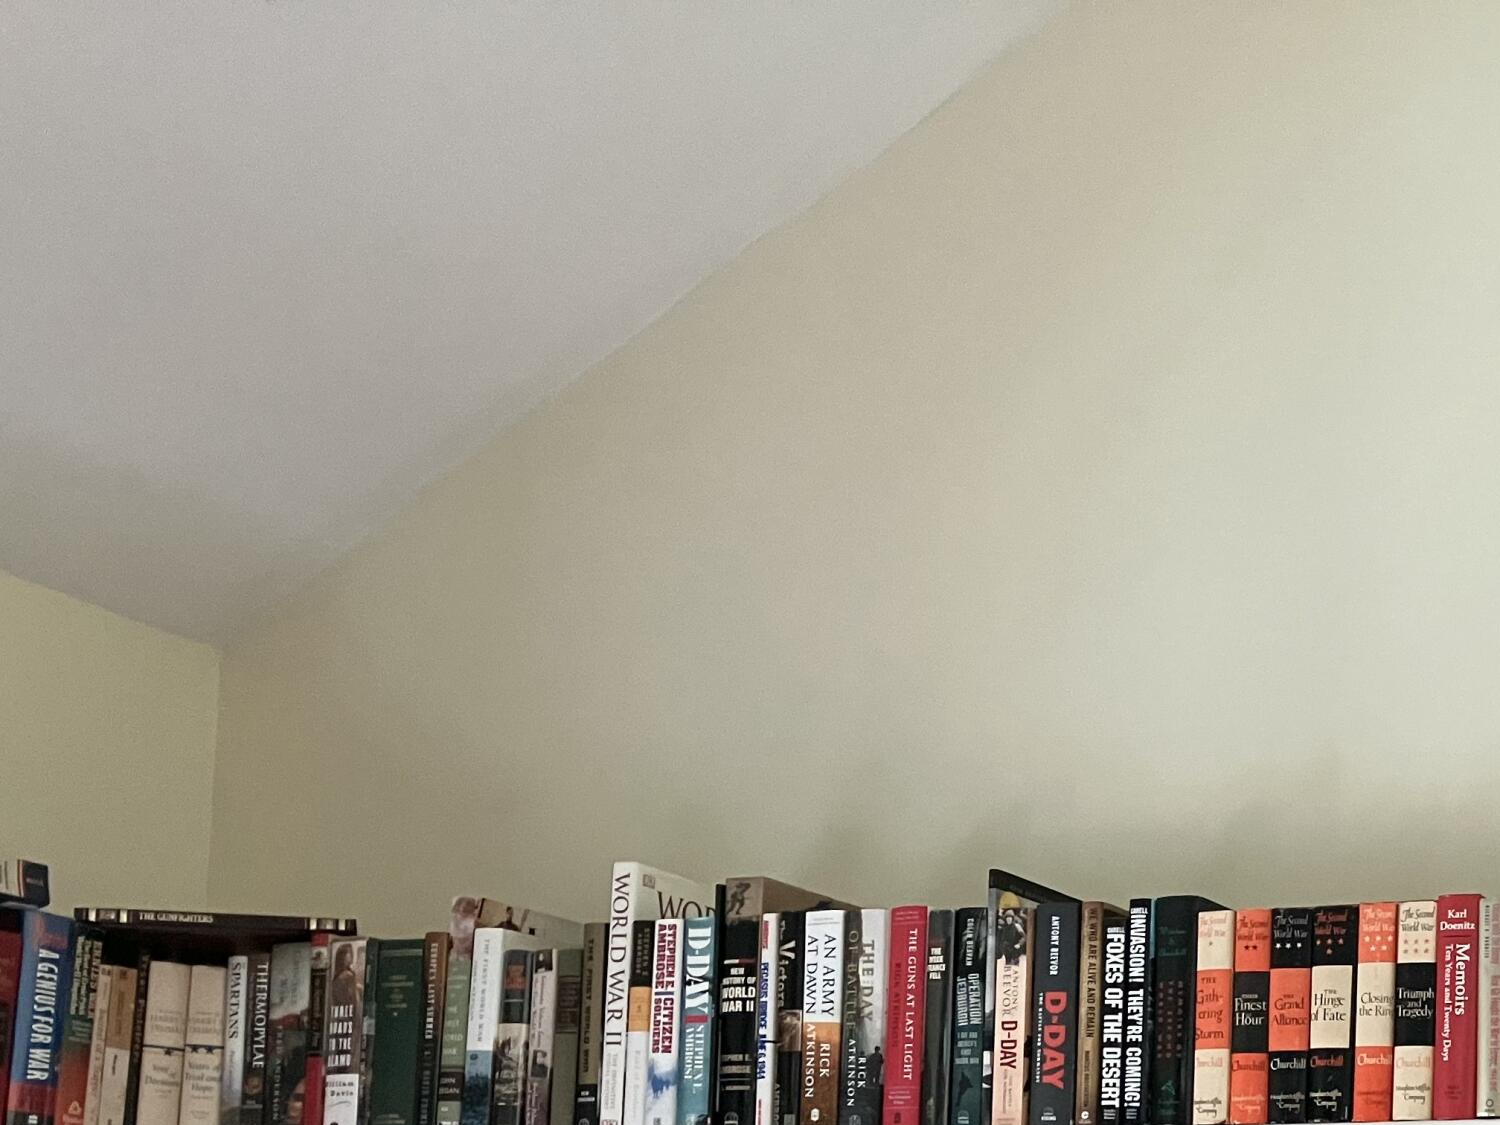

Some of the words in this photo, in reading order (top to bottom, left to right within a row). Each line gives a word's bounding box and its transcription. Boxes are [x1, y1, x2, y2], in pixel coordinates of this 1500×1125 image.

[156, 912, 214, 923] GUNFIGHTERS
[610, 873, 631, 964] WORLD
[1440, 920, 1476, 931] Doenitz
[1447, 908, 1468, 919] Karl
[806, 935, 819, 956] AT
[908, 927, 918, 953] THE
[1050, 916, 1060, 946] ANTONY
[1089, 922, 1098, 942] WHO
[38, 948, 60, 959] A
[654, 924, 667, 990] AMBROSE
[666, 923, 677, 975] STEPHEN
[824, 934, 838, 959] AN
[1088, 943, 1097, 960] ARE
[1104, 932, 1125, 983] FOXES
[1129, 913, 1149, 983] INVASION!
[1444, 944, 1454, 961] Ten
[684, 927, 713, 1014] D-DAY
[906, 956, 917, 990] GUNS
[1049, 947, 1059, 976] BEEVOR
[1087, 962, 1097, 985] ALIVE
[1444, 963, 1453, 987] Years
[33, 962, 59, 1014] GENIUS
[721, 986, 756, 999] WORLD
[805, 962, 819, 1014] DAWN
[821, 966, 836, 1017] ARMY
[1397, 987, 1435, 1001] Triumph
[1454, 943, 1471, 1016] Memoirs
[227, 960, 242, 1040] SPARTANS
[606, 969, 626, 1024] WAR
[905, 993, 915, 1006] AT
[968, 972, 980, 1025] OPERATION
[1087, 987, 1096, 1005] AND
[1104, 986, 1124, 1007] OF
[1234, 998, 1267, 1012] Finest
[1274, 997, 1305, 1010] Grand
[1314, 993, 1345, 1008] Hinge
[1443, 987, 1453, 1004] and
[252, 962, 270, 1070] THERMOPYLAE
[651, 998, 662, 1054] SOLDIERS
[660, 997, 674, 1054] CITIZEN
[904, 1011, 915, 1040] LAST
[1086, 1006, 1095, 1038] REMAIN
[1127, 988, 1144, 1042] THEY'RE
[1235, 1012, 1265, 1026] Hour
[1323, 1008, 1346, 1022] Fate
[1359, 1006, 1374, 1017] the
[1397, 1005, 1433, 1019] Tragedy
[1442, 1005, 1452, 1037] Twenty
[30, 1014, 54, 1043] FOR
[605, 1031, 622, 1046] II
[1040, 990, 1068, 1090] D-DAY
[1103, 1012, 1123, 1043] THE
[999, 1020, 1018, 1070] D-DAY
[1442, 1039, 1452, 1062] Days
[26, 1048, 53, 1081] WAR
[804, 1023, 816, 1099] ATKINSON
[818, 1043, 832, 1078] RICK
[846, 1038, 856, 1107] ATKINSON
[857, 1057, 867, 1089] RICK
[903, 1042, 914, 1081] LIGHT
[1232, 1060, 1266, 1072] Churchill
[1270, 1057, 1306, 1071] Churchill
[1310, 1055, 1344, 1068] Churchill
[1101, 1047, 1121, 1108] DESERT
[1125, 1048, 1142, 1108] COMING!
